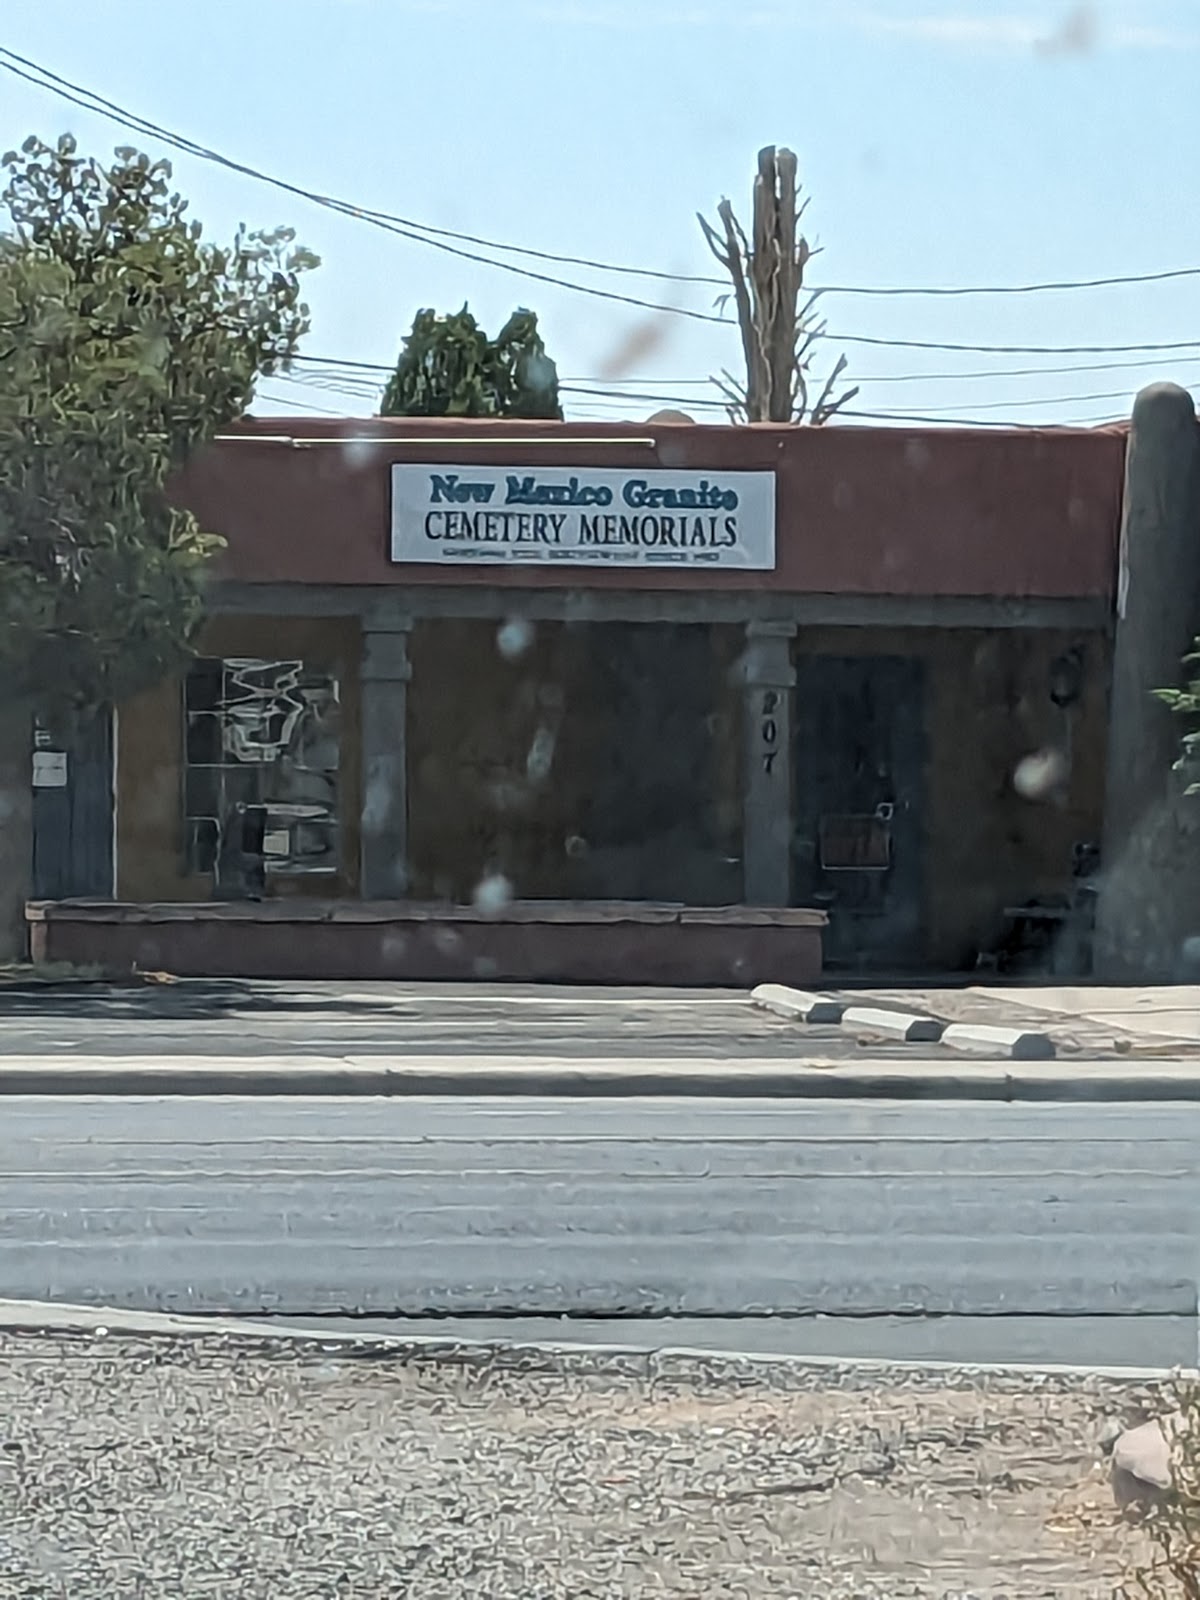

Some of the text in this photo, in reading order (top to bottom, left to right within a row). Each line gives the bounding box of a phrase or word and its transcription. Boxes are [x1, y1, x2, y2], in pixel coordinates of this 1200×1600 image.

[430, 475, 494, 503] New
[623, 480, 738, 511] Granite
[425, 511, 736, 546] CEMETERY MEMORIALS
